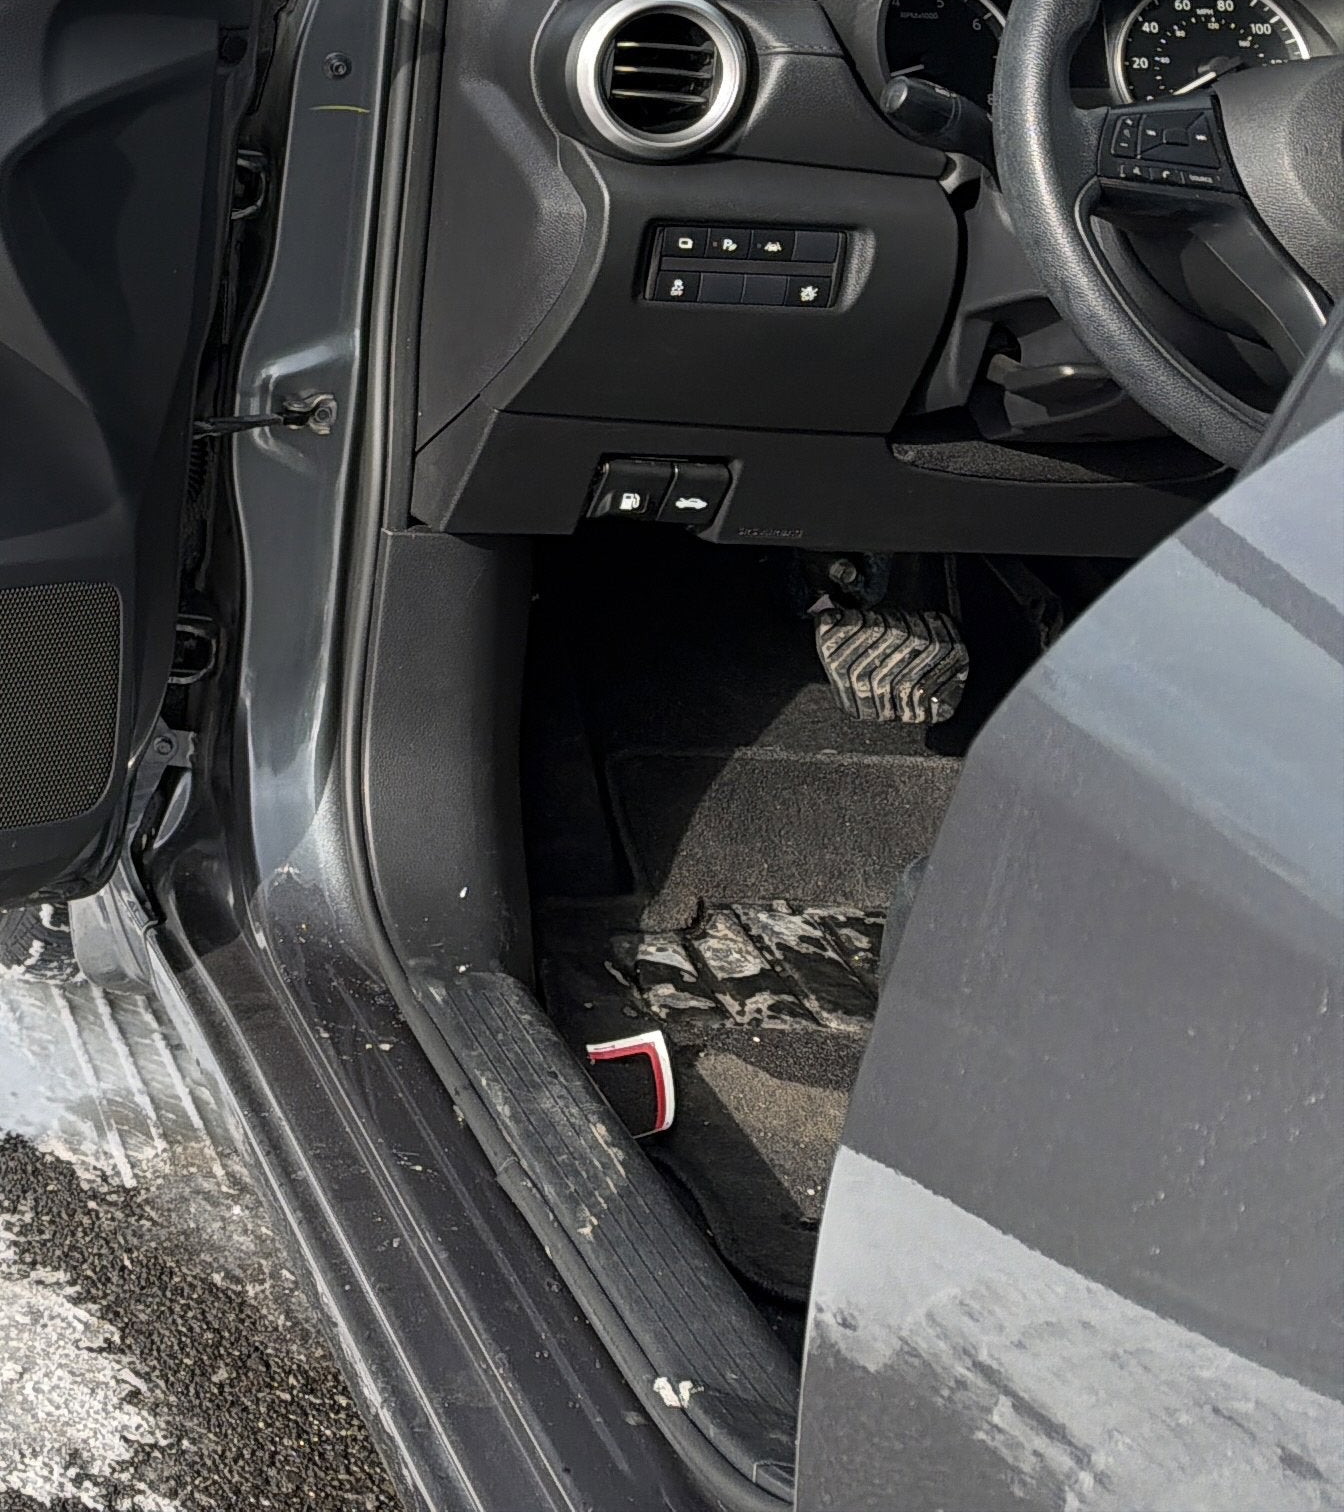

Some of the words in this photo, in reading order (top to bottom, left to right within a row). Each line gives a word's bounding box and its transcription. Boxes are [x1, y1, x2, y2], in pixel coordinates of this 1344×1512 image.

[1174, 0, 1191, 11] 60
[1216, 0, 1234, 12] 80
[1196, 8, 1214, 16] MPH
[972, 18, 982, 31] 6
[1141, 21, 1159, 34] 40
[1250, 23, 1272, 35] 100
[1132, 57, 1149, 69] 20
